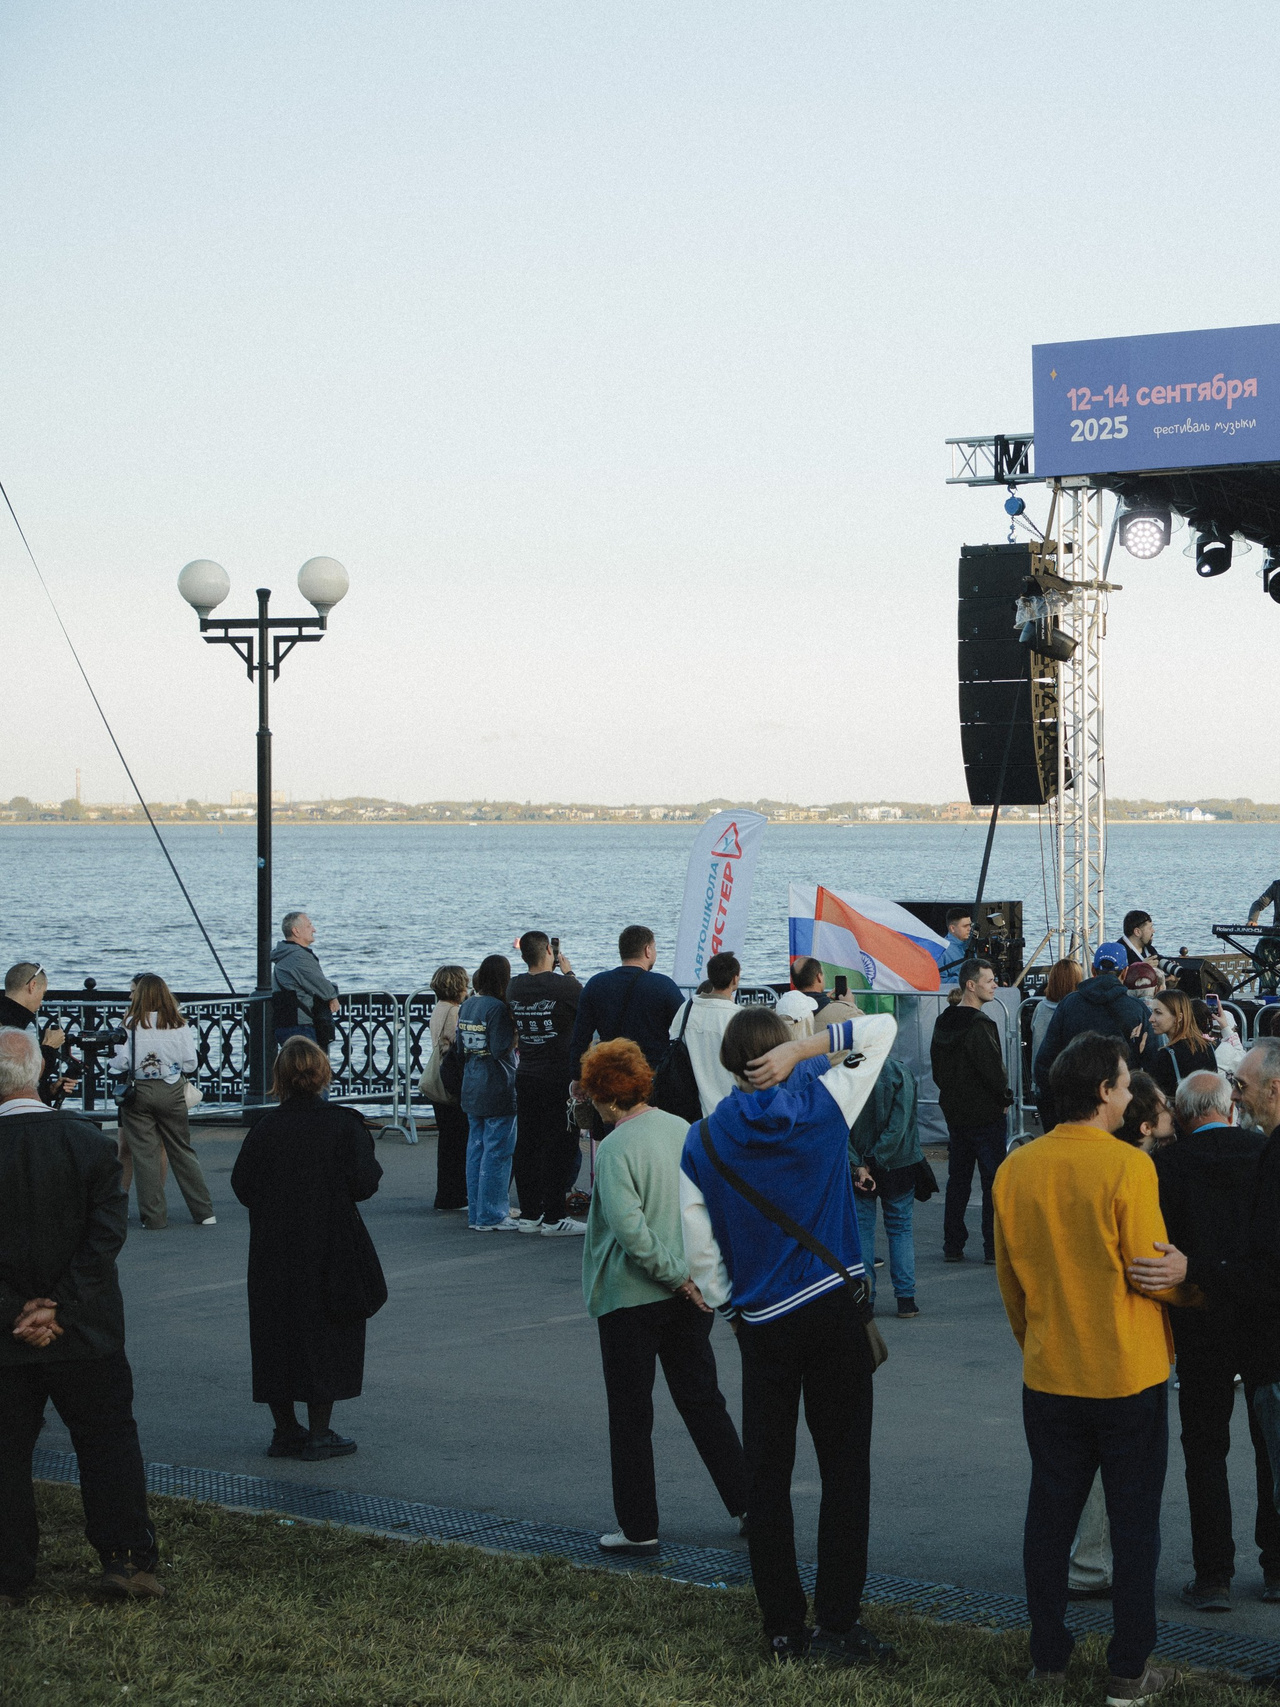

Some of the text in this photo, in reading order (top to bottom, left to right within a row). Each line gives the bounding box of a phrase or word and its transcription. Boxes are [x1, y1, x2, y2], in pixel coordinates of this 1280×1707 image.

[1066, 373, 1258, 412] 12-14 сентября
[1070, 415, 1129, 442] 2025
[1153, 417, 1257, 439] фестиваль музыки
[694, 862, 719, 980] АВТОШКОЛА
[710, 861, 734, 959] АСТЕР
